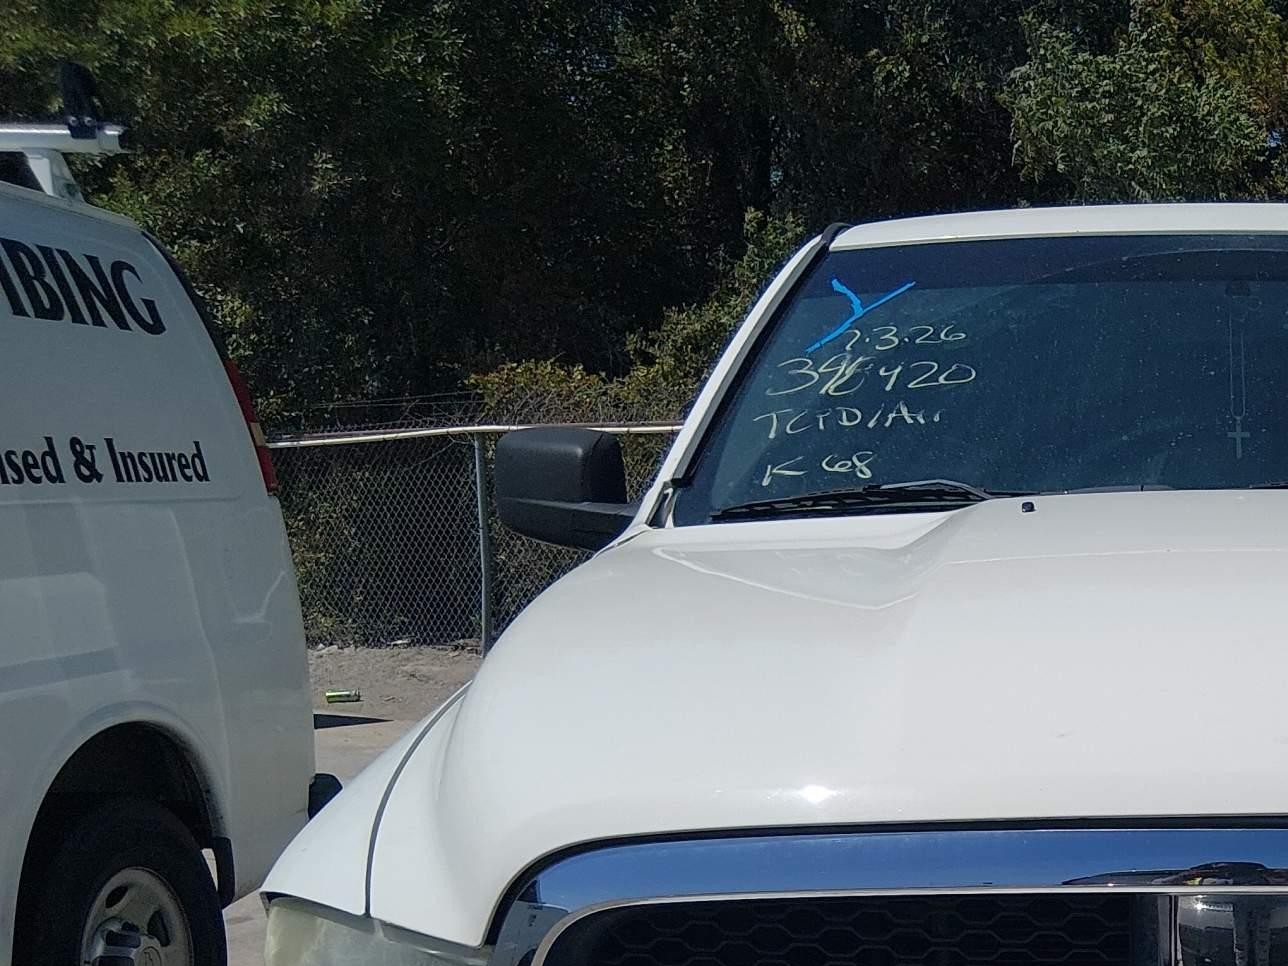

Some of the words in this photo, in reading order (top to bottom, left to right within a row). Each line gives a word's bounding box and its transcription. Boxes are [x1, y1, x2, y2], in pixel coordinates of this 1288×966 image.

[69, 436, 104, 484] &
[104, 437, 211, 483] Insured
[820, 450, 874, 479] 68
